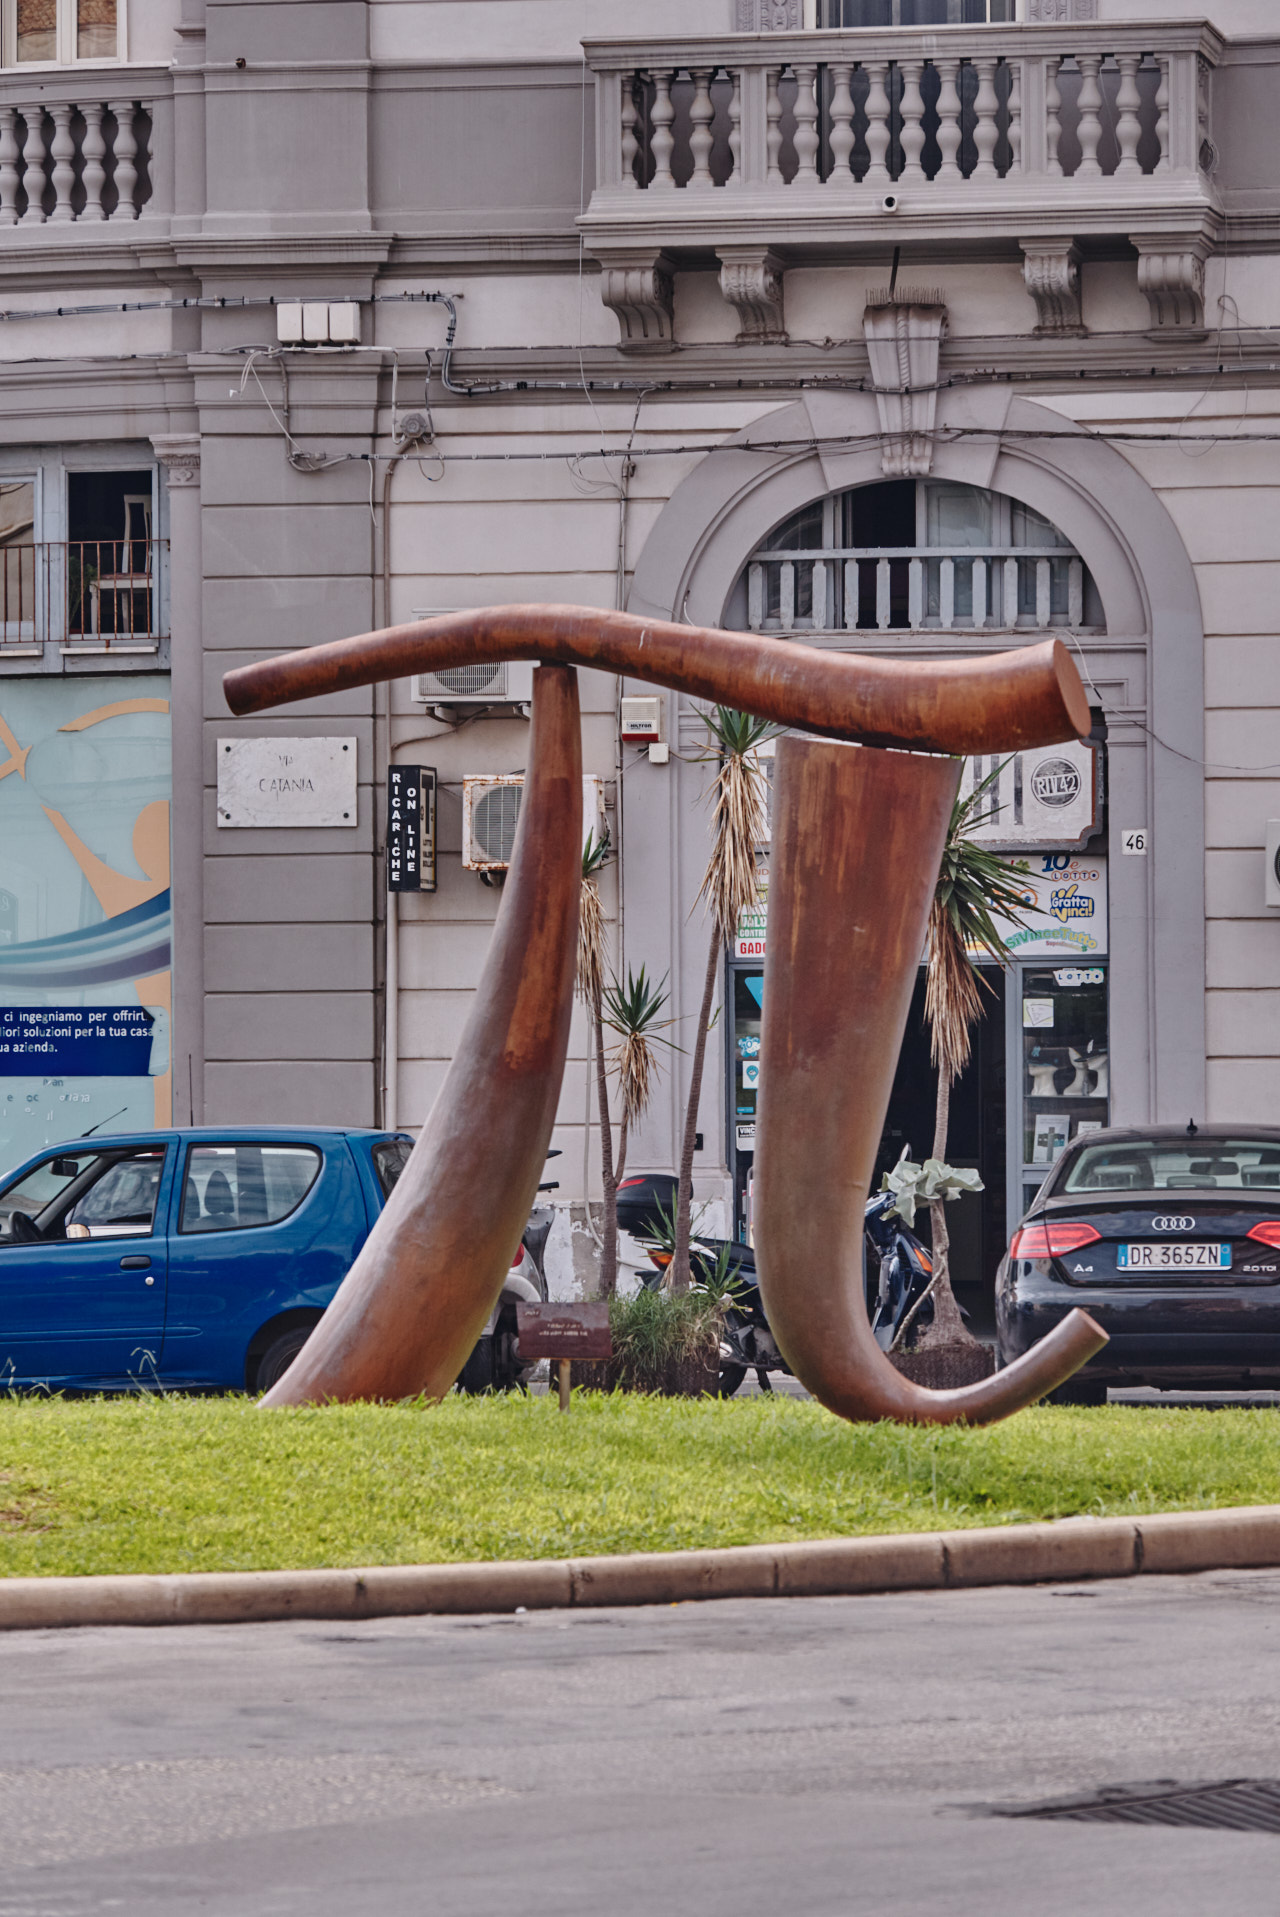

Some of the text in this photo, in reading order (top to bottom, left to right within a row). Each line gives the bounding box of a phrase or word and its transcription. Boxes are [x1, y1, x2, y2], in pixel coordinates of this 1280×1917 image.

[259, 778, 314, 793] CATANIA
[391, 773, 401, 881] RICARICHE
[406, 787, 416, 872] ON LINE
[1126, 834, 1144, 850] 46
[1042, 855, 1070, 872] 10
[1052, 896, 1089, 908] Gratta
[1055, 898, 1093, 922] Vinci!
[1005, 926, 1097, 951] SiVinceTutto
[4, 1011, 13, 1022] ci
[19, 1011, 82, 1024] ingegniamo
[89, 1012, 107, 1024] per
[23, 1026, 72, 1037] soluzioni
[74, 1029, 93, 1039] per
[96, 1026, 106, 1037] la
[109, 1027, 127, 1037] tua
[13, 1042, 58, 1053] azienda.
[1131, 1246, 1218, 1265] DR 365ZN
[1073, 1263, 1094, 1273] A4
